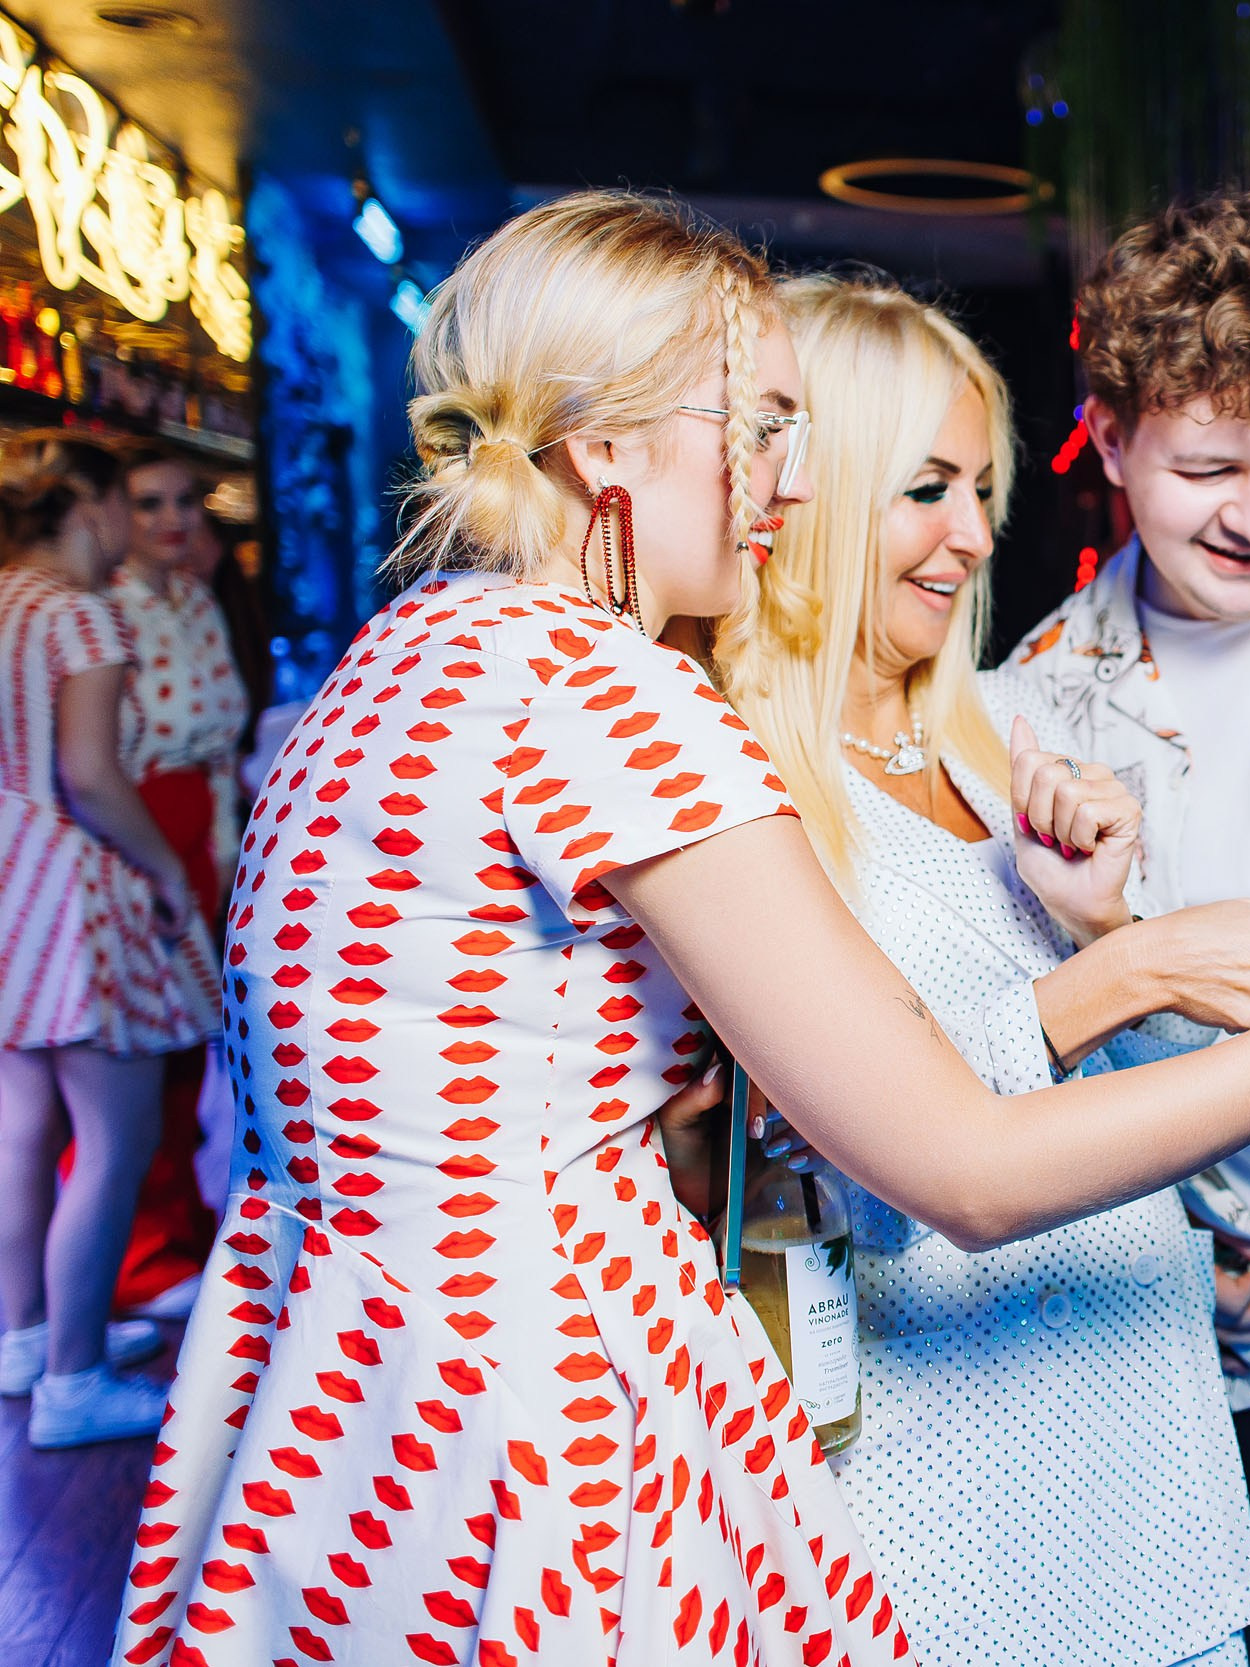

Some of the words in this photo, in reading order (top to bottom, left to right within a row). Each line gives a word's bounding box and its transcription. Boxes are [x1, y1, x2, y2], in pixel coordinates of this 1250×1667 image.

[808, 1292, 849, 1316] ABRAU
[808, 1308, 849, 1326] VINONADE
[821, 1336, 843, 1349] zero
